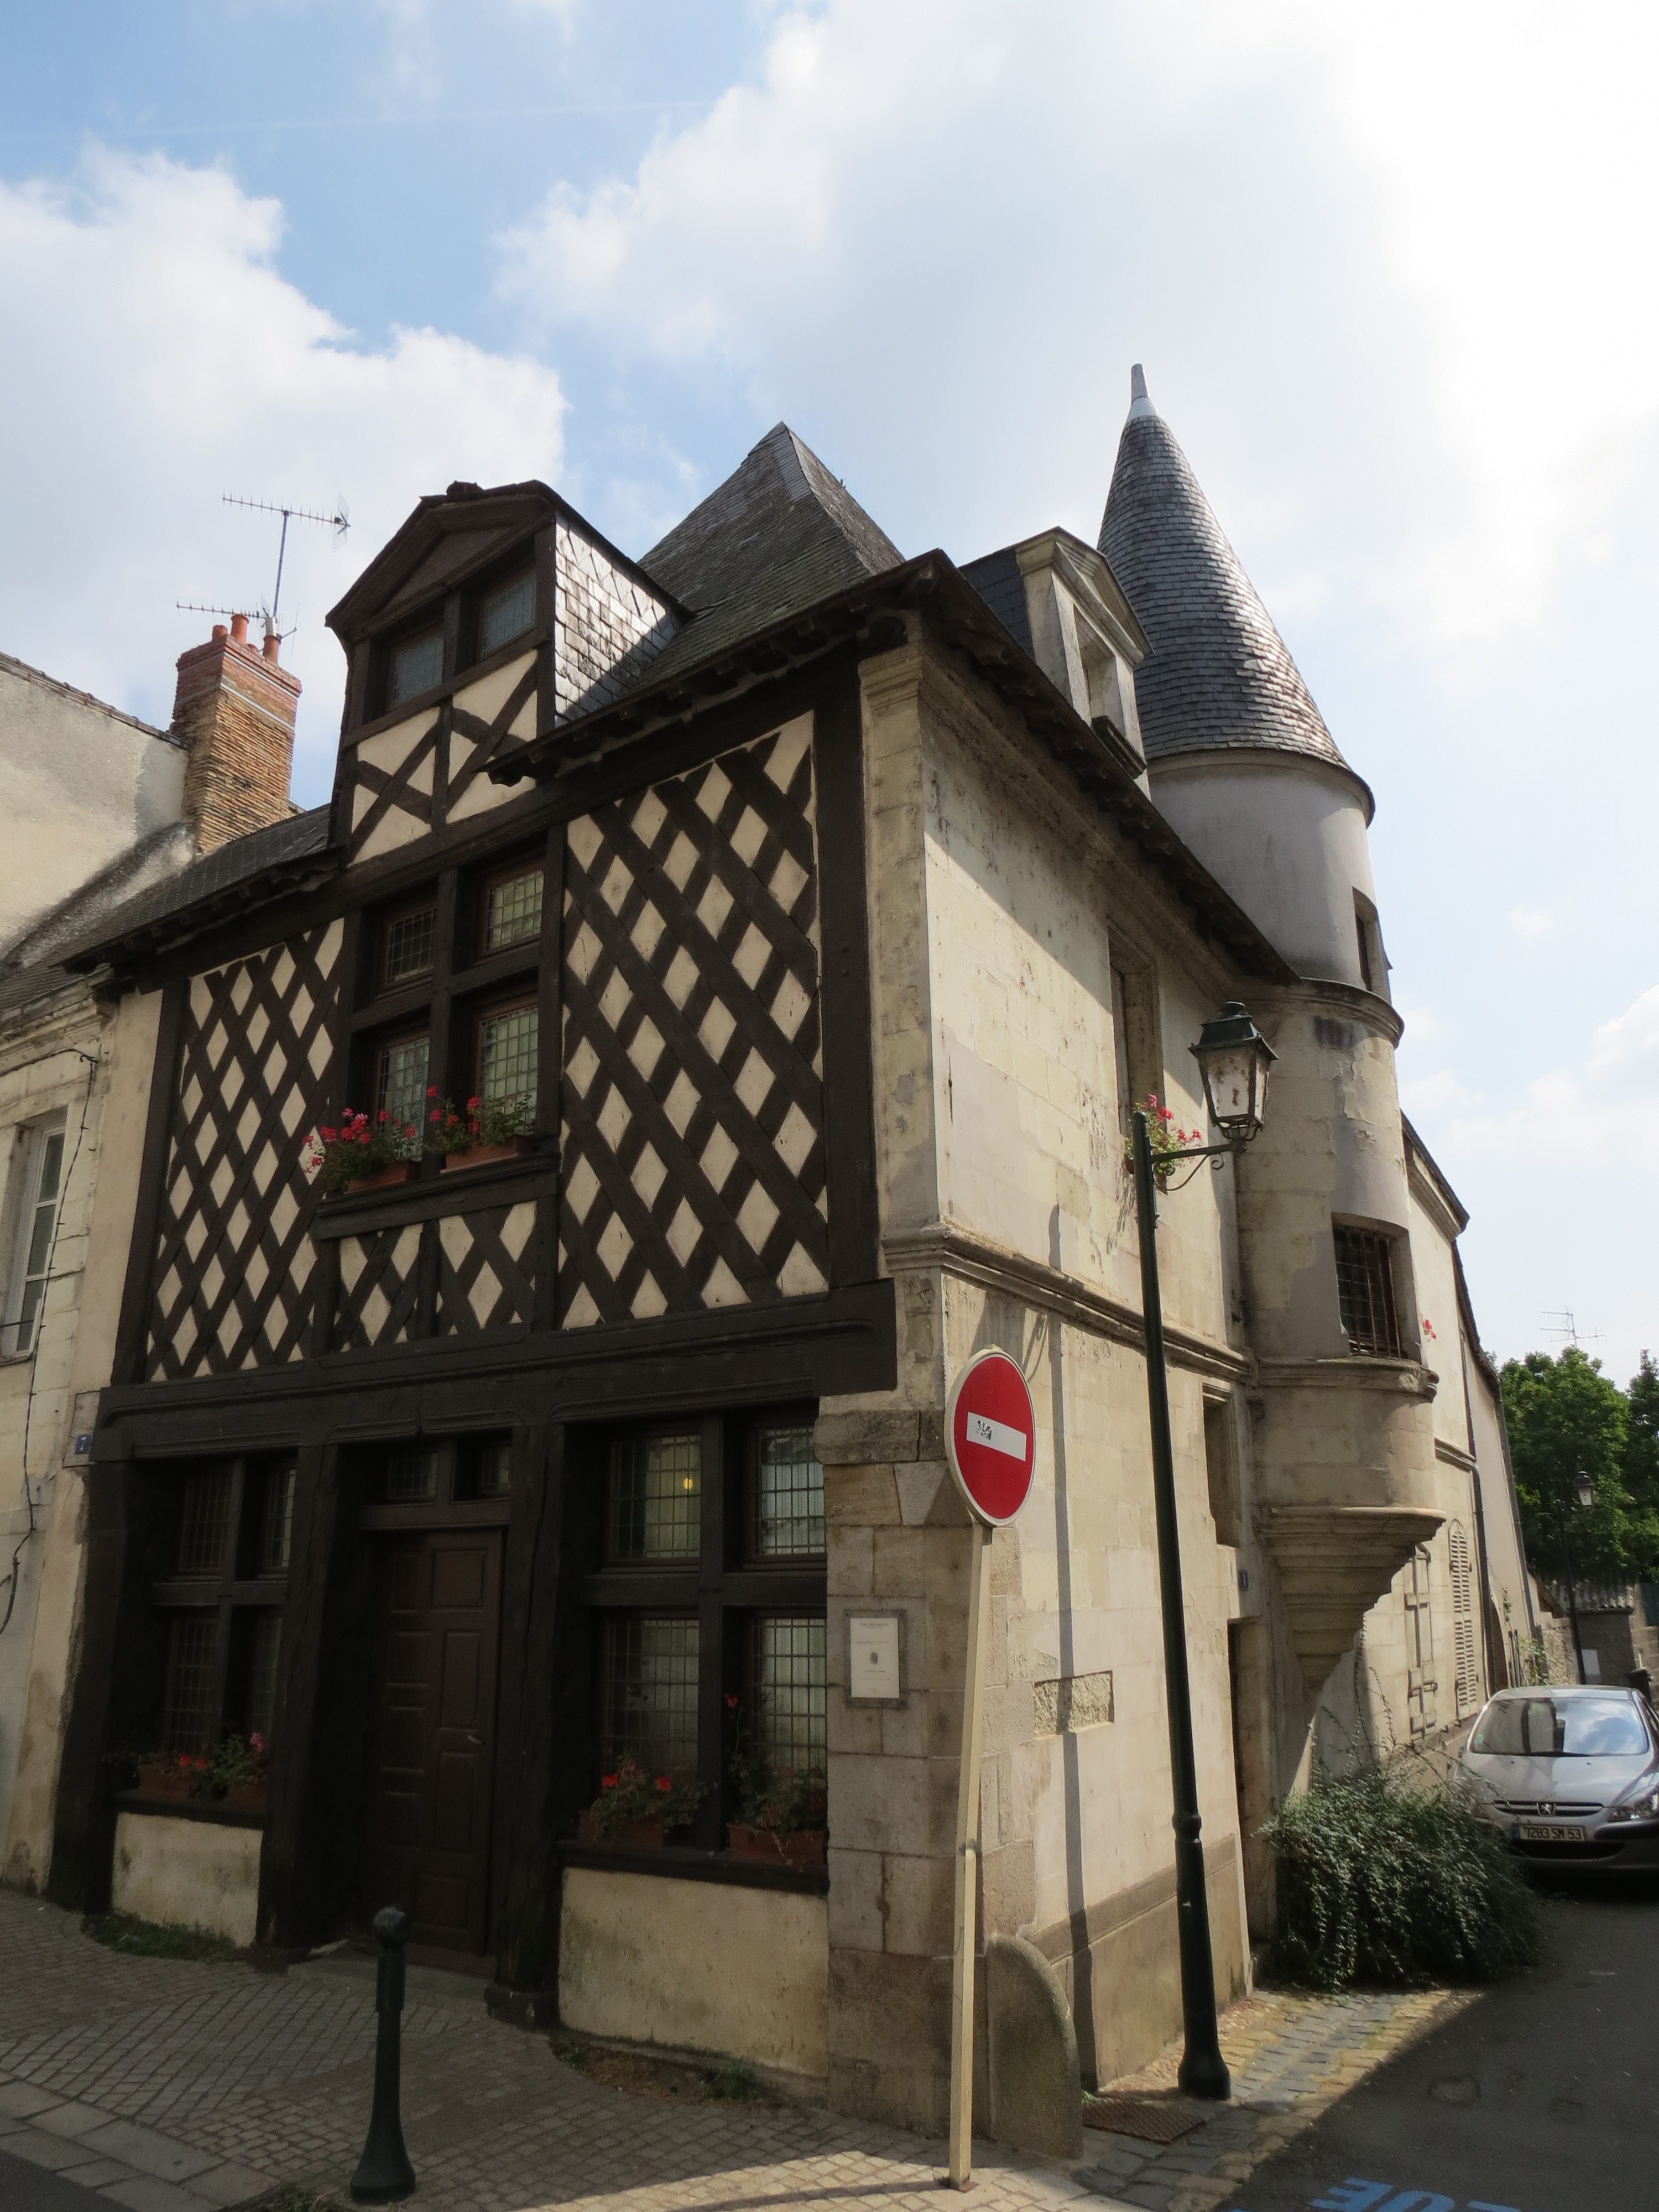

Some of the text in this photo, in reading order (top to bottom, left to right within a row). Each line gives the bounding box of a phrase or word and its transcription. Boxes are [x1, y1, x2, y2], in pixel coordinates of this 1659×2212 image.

[80, 1437, 87, 1451] 7
[1551, 1827, 1564, 1839] SM
[1567, 1828, 1581, 1840] 53
